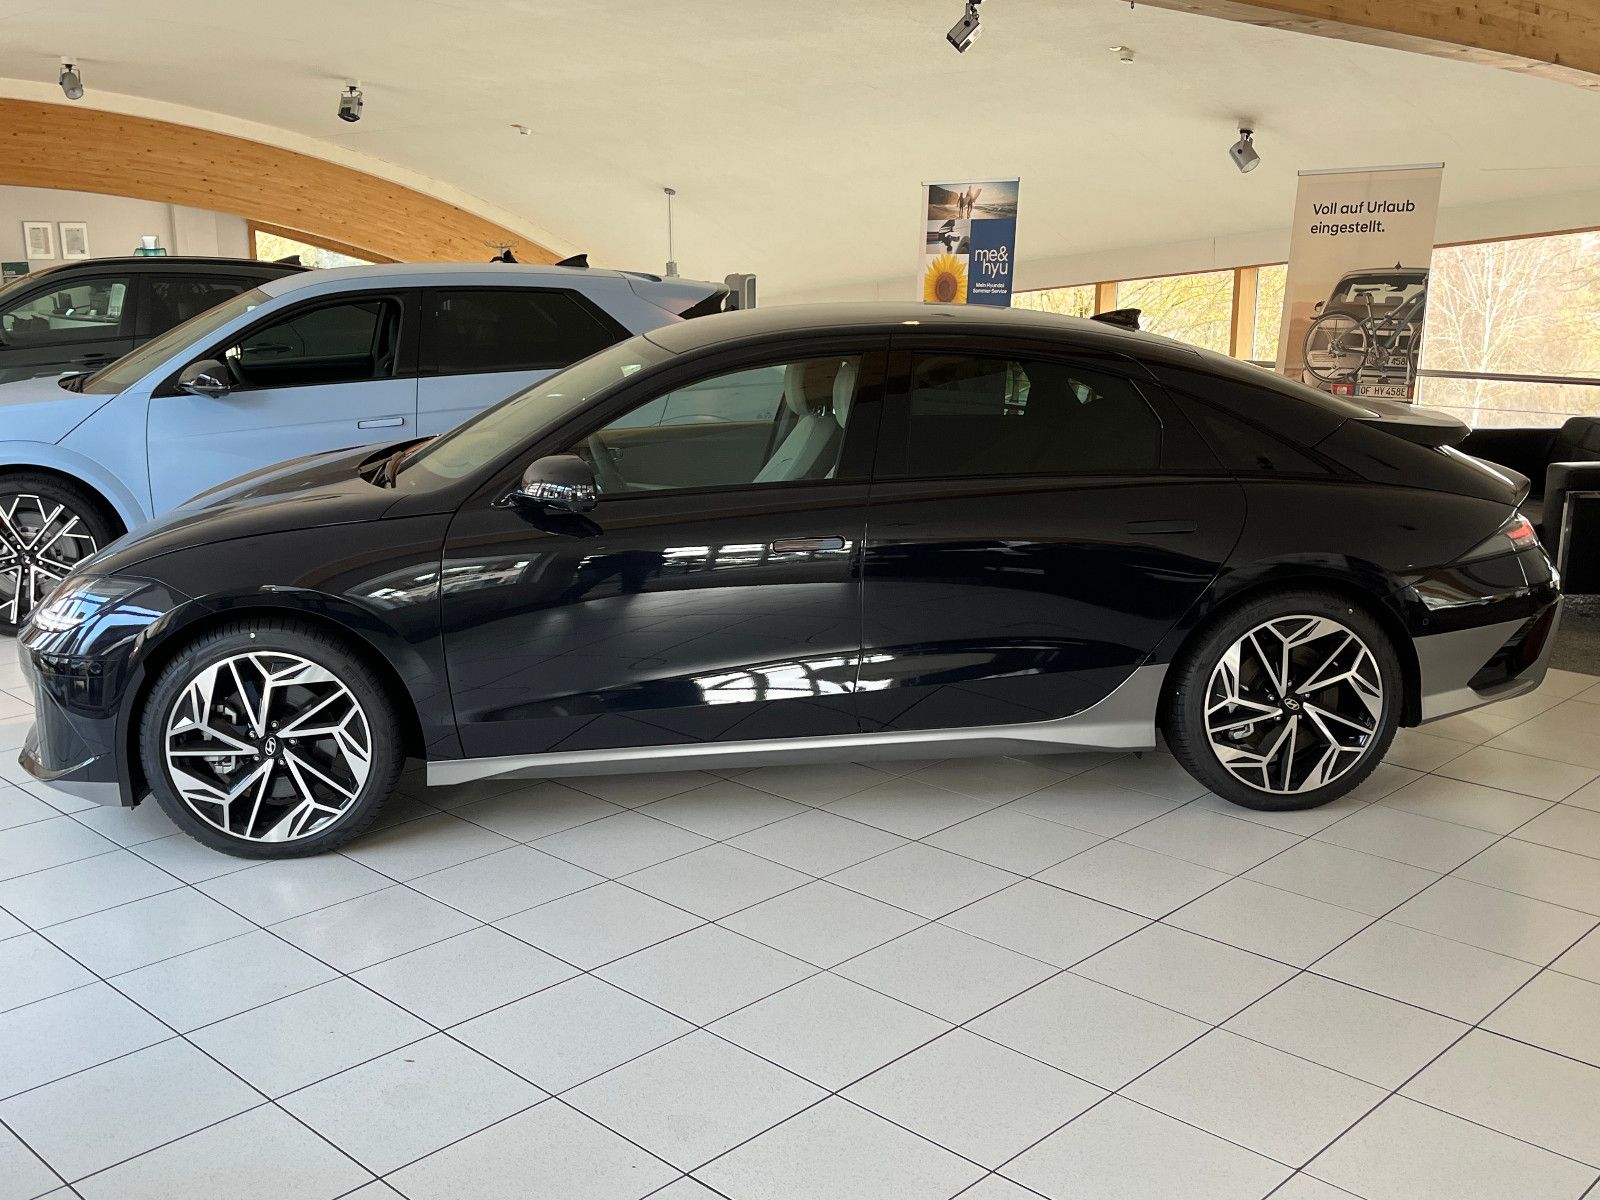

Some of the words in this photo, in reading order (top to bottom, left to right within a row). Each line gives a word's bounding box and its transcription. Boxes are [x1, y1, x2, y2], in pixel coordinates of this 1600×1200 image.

[1313, 202, 1337, 215] Voll
[1340, 201, 1365, 215] auf
[1367, 200, 1415, 214] Urlaub
[1310, 220, 1385, 236] eingestellt.
[974, 245, 1008, 262] me&
[982, 259, 1008, 278] hyu
